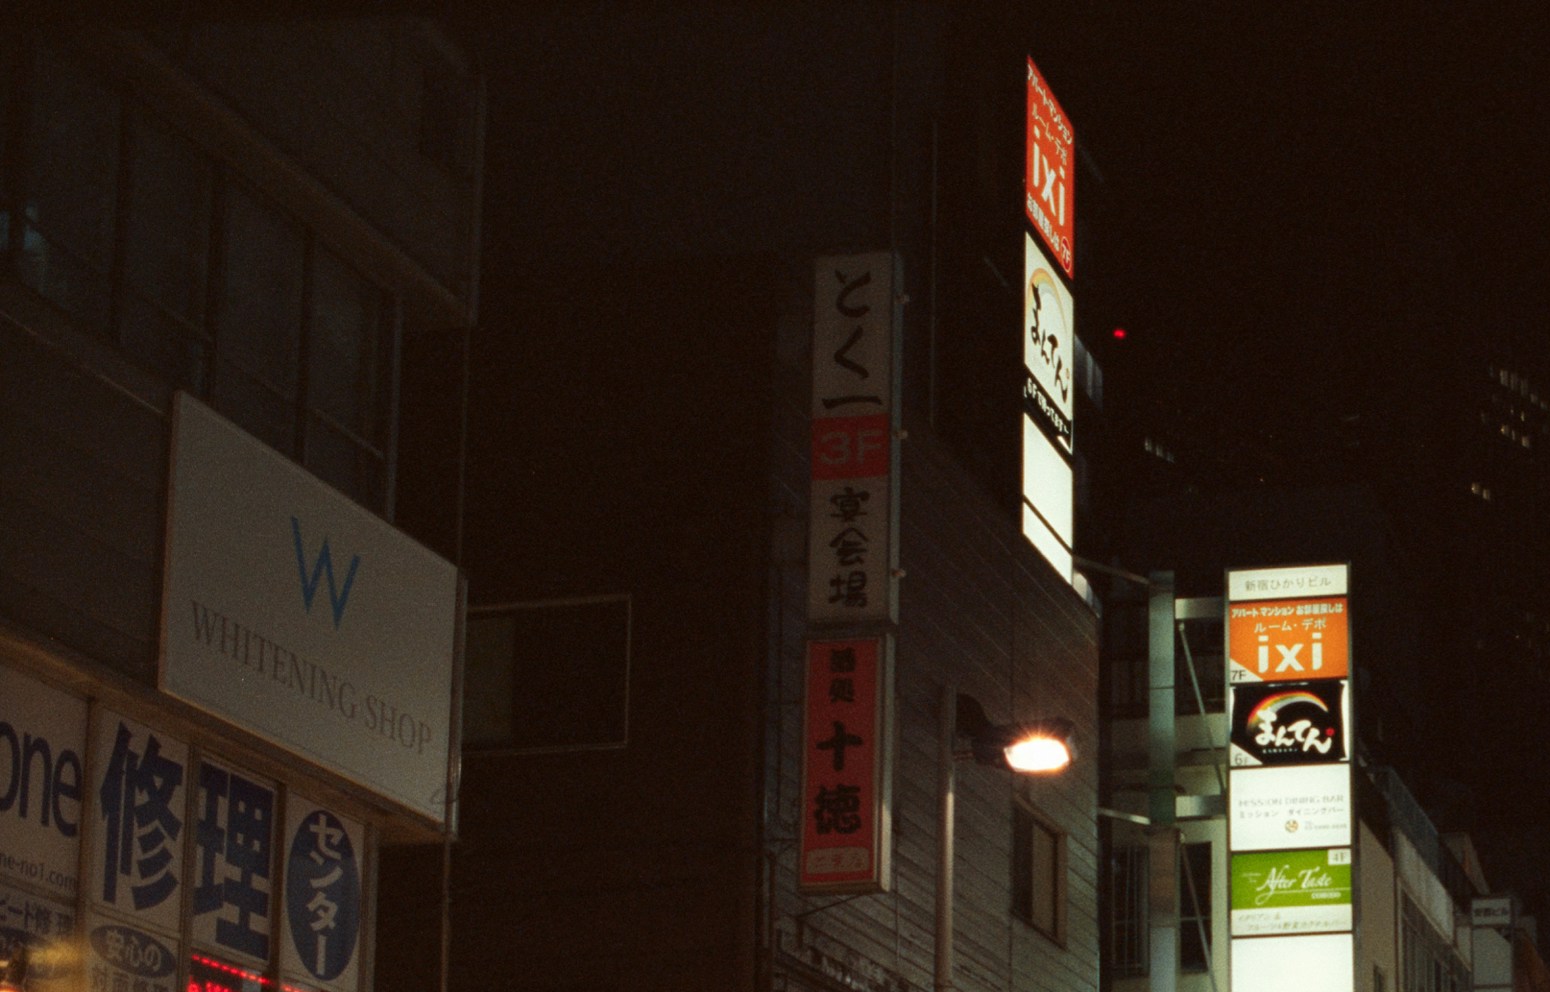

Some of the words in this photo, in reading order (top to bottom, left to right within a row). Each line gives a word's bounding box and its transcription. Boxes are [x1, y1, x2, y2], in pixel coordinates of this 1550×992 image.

[1033, 125, 1065, 227] ixi
[820, 429, 883, 465] 3F
[829, 487, 869, 608] 宴会場
[1231, 669, 1247, 681] 7F
[1257, 632, 1323, 674] ixi
[191, 601, 358, 721] WHITENING
[364, 691, 433, 757] SHOP
[1255, 706, 1333, 755] まんてん
[814, 720, 863, 834] 十徳
[100, 721, 276, 963] 修理
[306, 812, 345, 975] センター
[1256, 864, 1297, 906] After
[104, 929, 163, 973] 安心の
